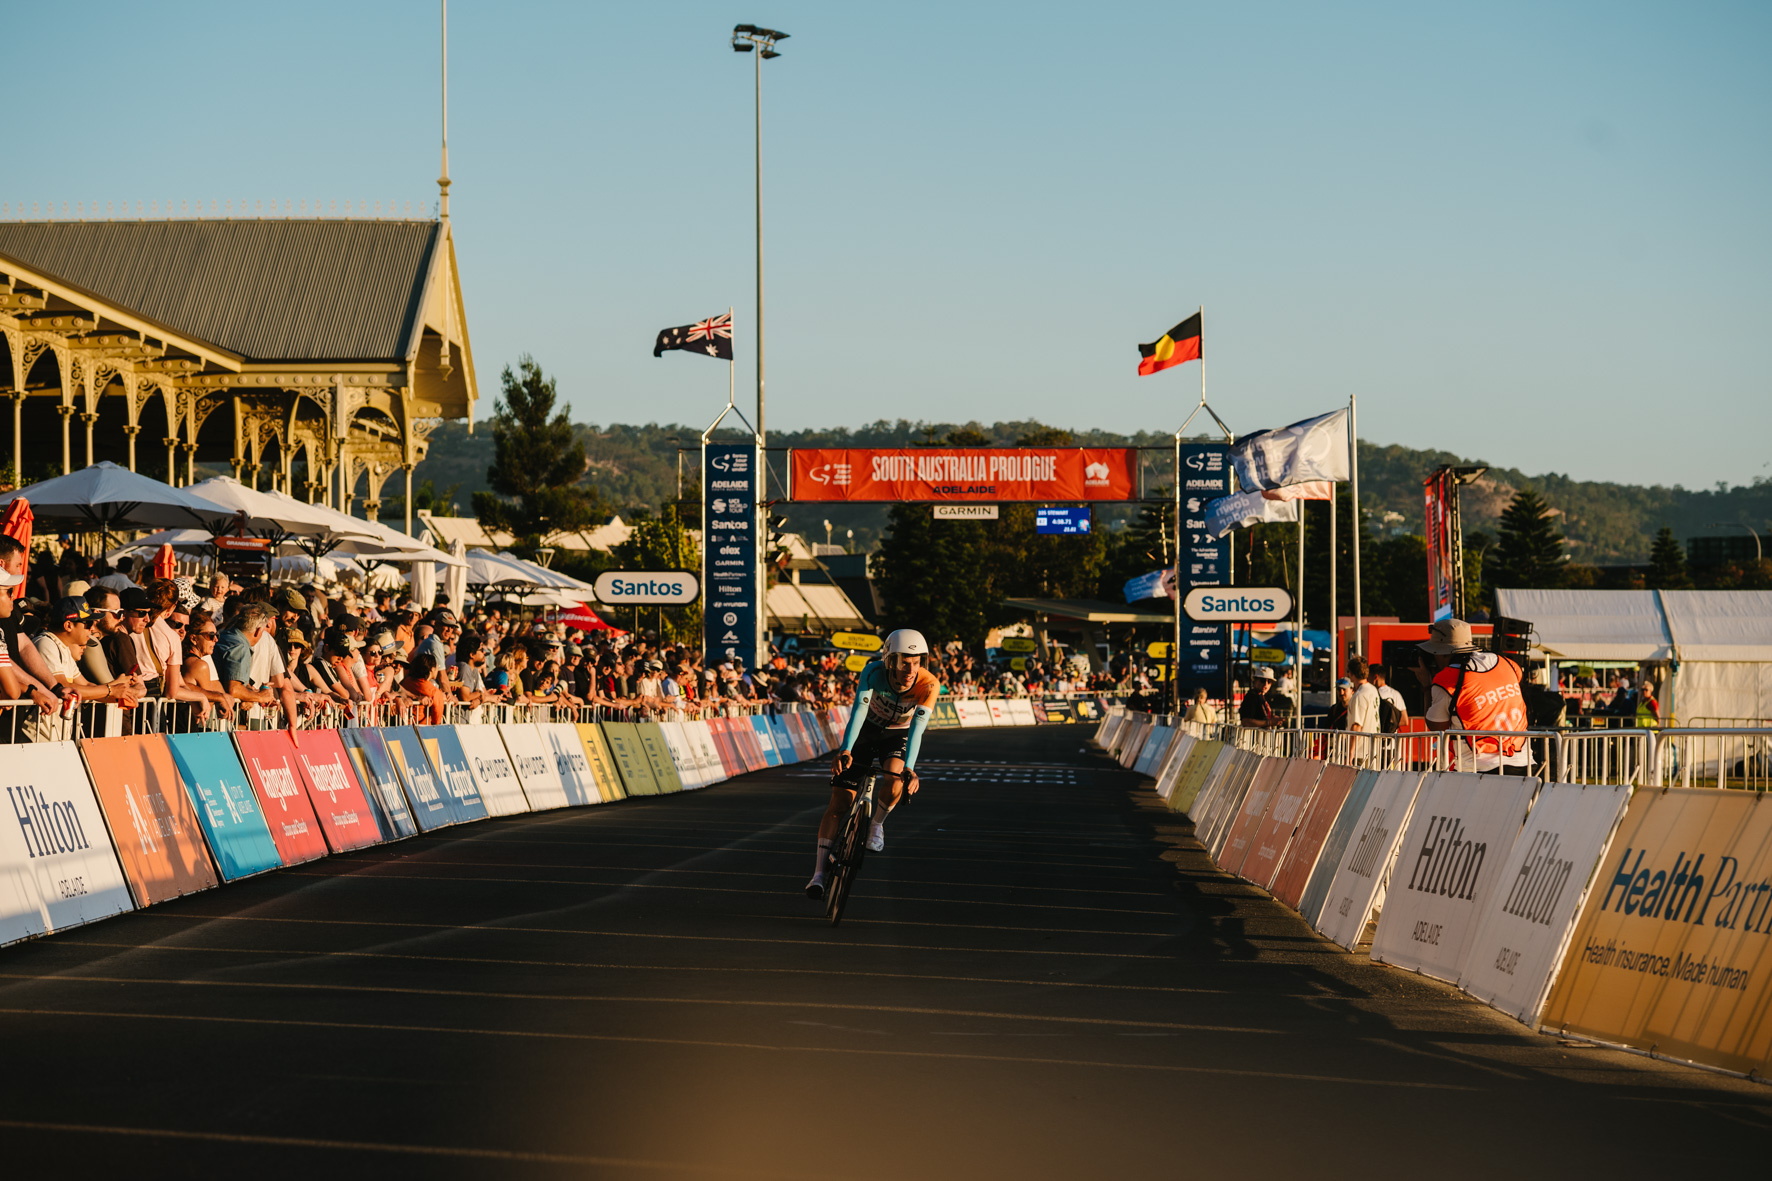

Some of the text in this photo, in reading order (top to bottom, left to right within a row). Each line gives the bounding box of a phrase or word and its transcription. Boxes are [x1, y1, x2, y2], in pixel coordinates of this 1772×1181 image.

[871, 456, 1057, 482] SOUTH AUSTRALIA PROLOGUE
[711, 480, 748, 488] ADELAIDE
[932, 485, 996, 494] ADELAIDE
[1186, 479, 1224, 487] ADELAIDE
[938, 507, 992, 515] GARMIN
[711, 520, 748, 529] Santos
[226, 540, 264, 548] GRANDSTAND
[611, 579, 683, 596] Santos
[718, 585, 742, 593] Hilton
[1201, 596, 1275, 612] Santos
[1474, 682, 1522, 710] PRESS
[251, 755, 300, 812] Vanguard
[300, 751, 351, 804] Vanguard
[6, 784, 90, 859] Hilton
[1347, 806, 1389, 879] Hilton
[1407, 815, 1488, 901] Hilton
[58, 876, 88, 899] ADELAIDE
[1502, 830, 1574, 926] Hilton
[1411, 920, 1443, 946] ADELAIDE
[1581, 936, 1749, 992] Health insurance. Made human.
